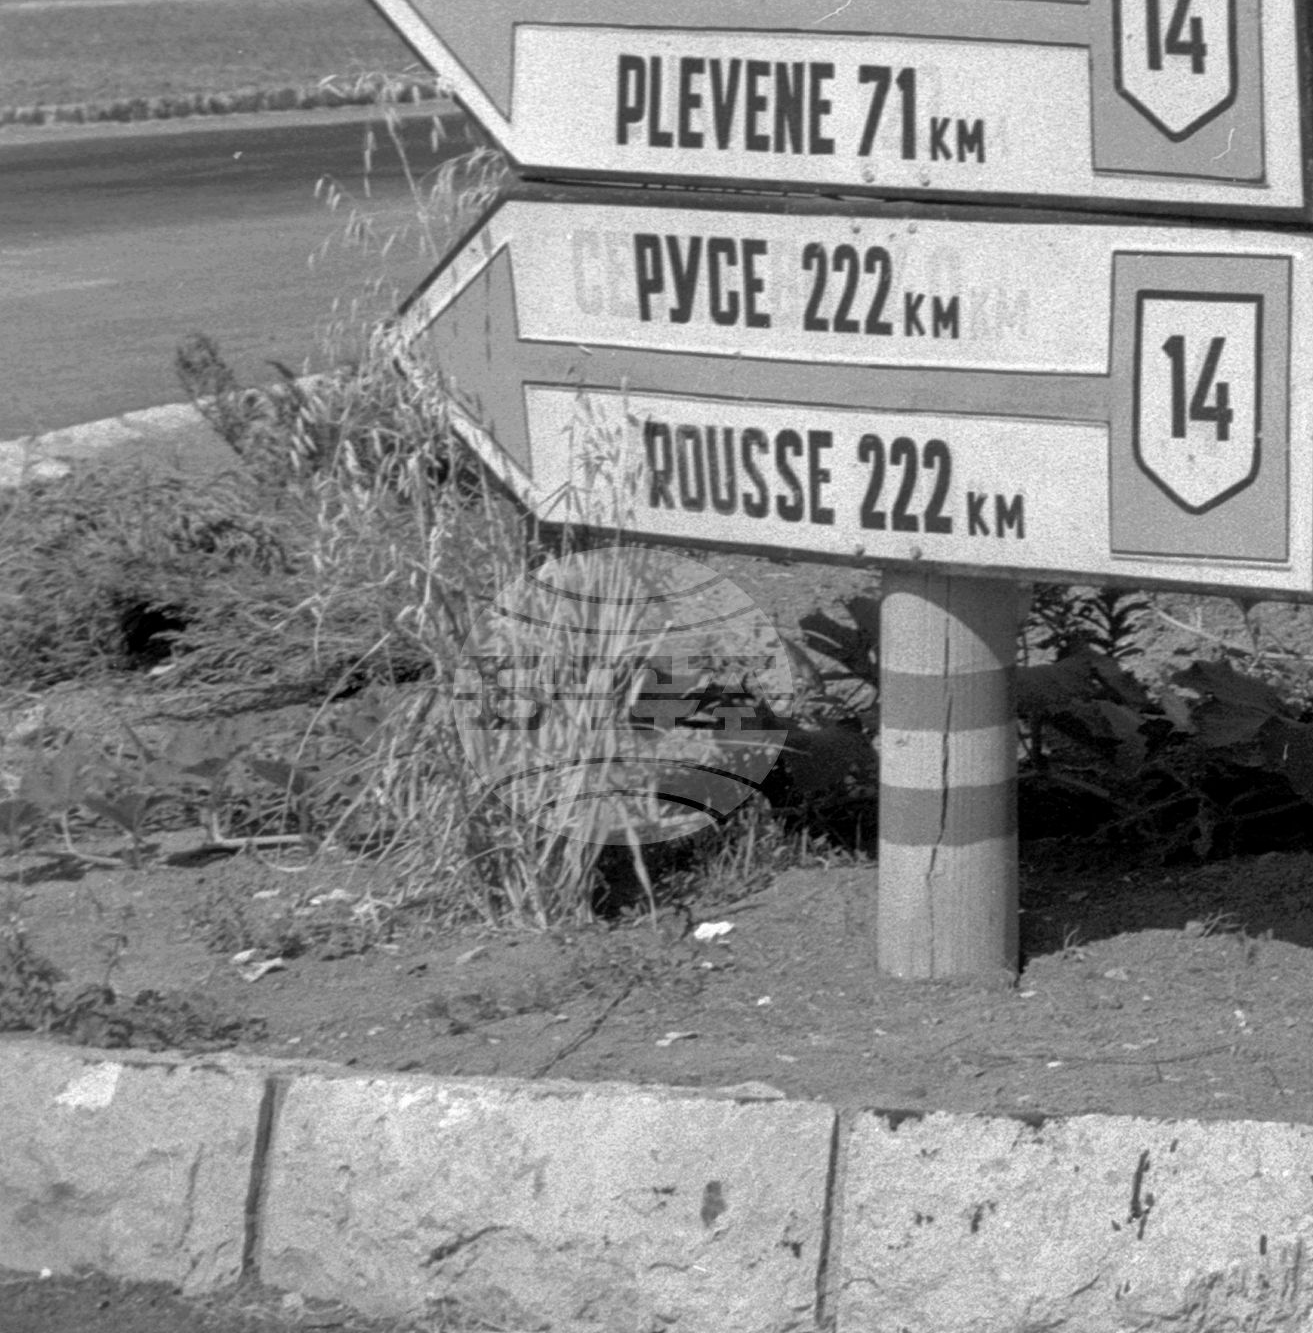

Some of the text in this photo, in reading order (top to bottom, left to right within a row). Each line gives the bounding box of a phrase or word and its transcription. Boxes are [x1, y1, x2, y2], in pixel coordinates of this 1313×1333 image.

[617, 55, 834, 155] PLEVENE
[859, 65, 916, 159] 71
[634, 233, 770, 328] РУСЕ
[803, 243, 892, 335] 222
[1163, 335, 1233, 441] 14
[643, 420, 834, 525] ROUSSE
[858, 434, 952, 534] 222
